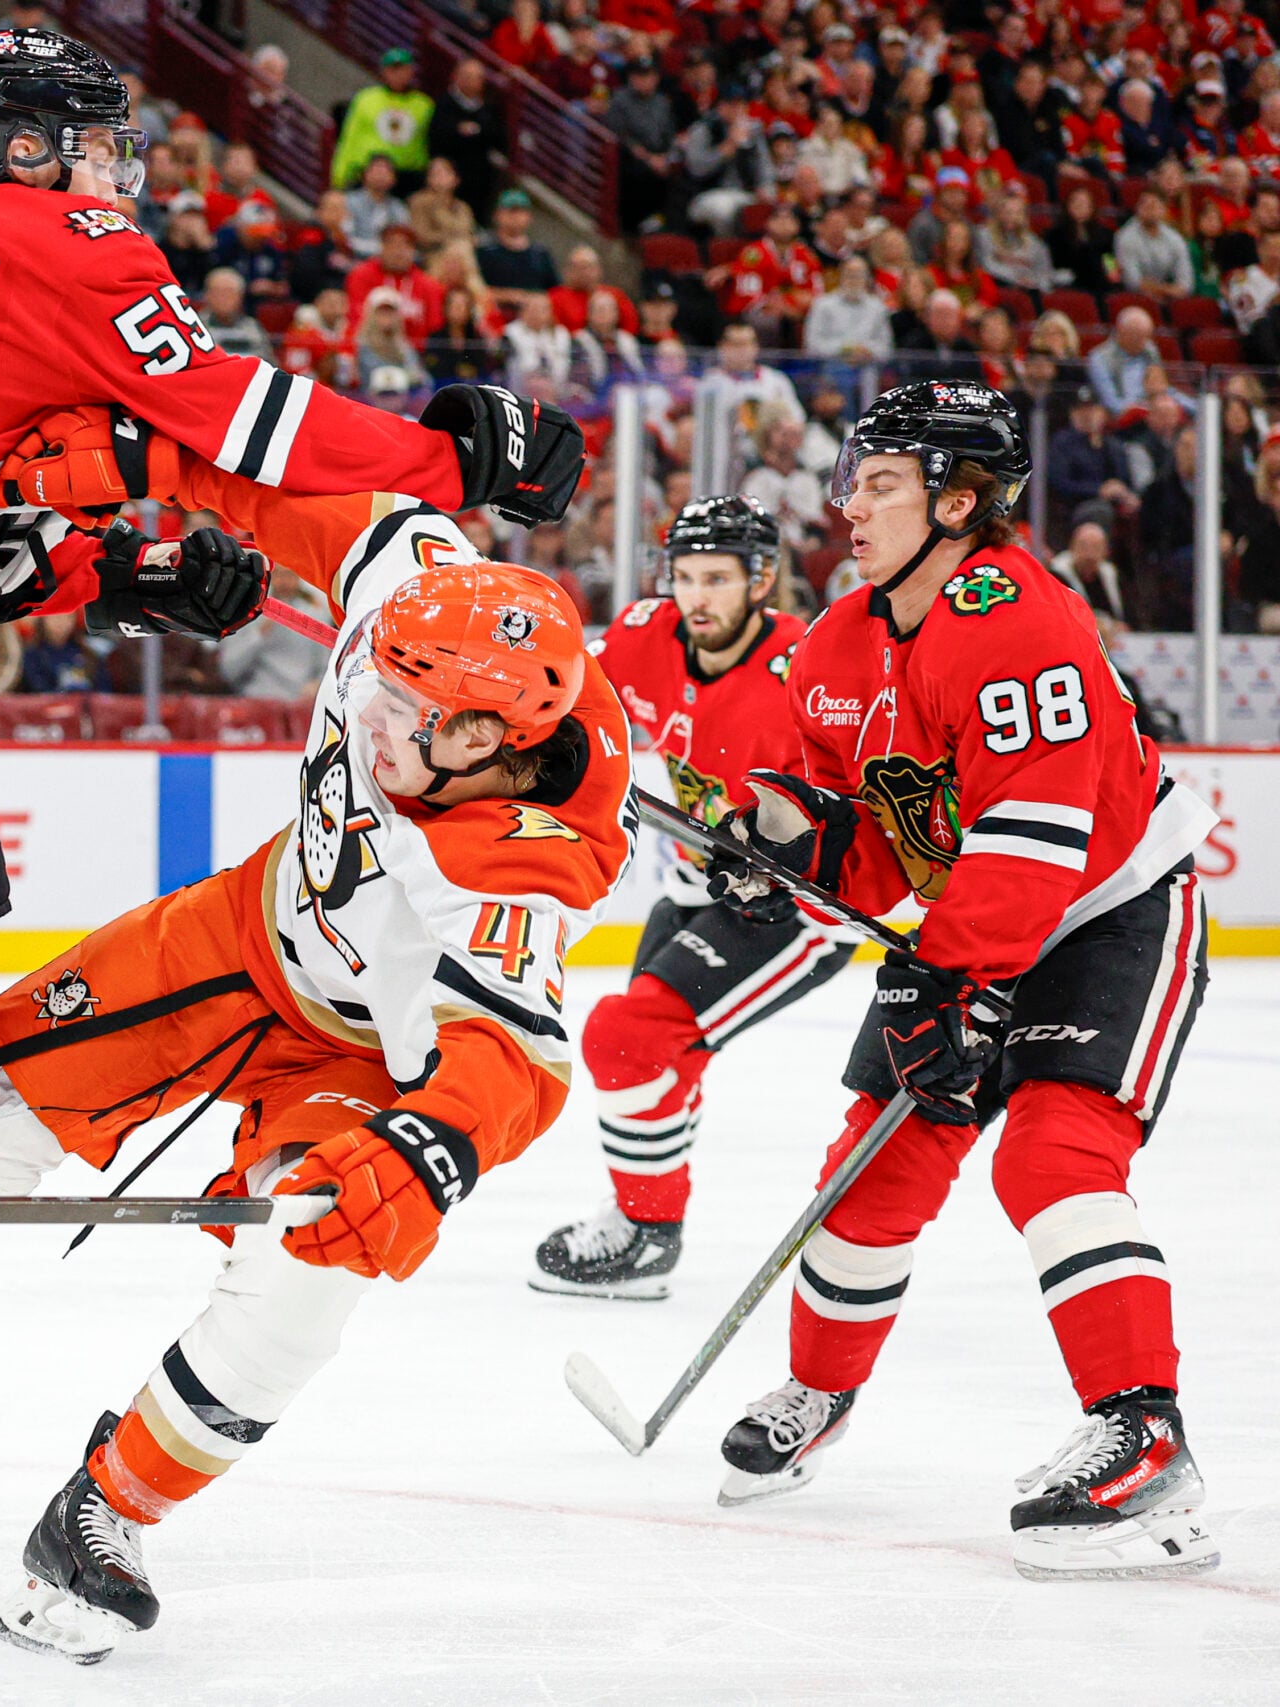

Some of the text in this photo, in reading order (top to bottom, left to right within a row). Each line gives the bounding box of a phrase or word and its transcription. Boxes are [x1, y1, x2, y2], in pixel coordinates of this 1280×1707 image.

[22, 36, 64, 49] BELLE
[27, 45, 59, 57] TIRE
[111, 282, 215, 377] 55
[957, 387, 994, 400] BELLE
[806, 684, 863, 718] Circa
[977, 661, 1092, 756] 98
[822, 713, 862, 727] SPORTS
[1004, 1024, 1101, 1049] CCM
[1100, 1468, 1146, 1502] BAUER
